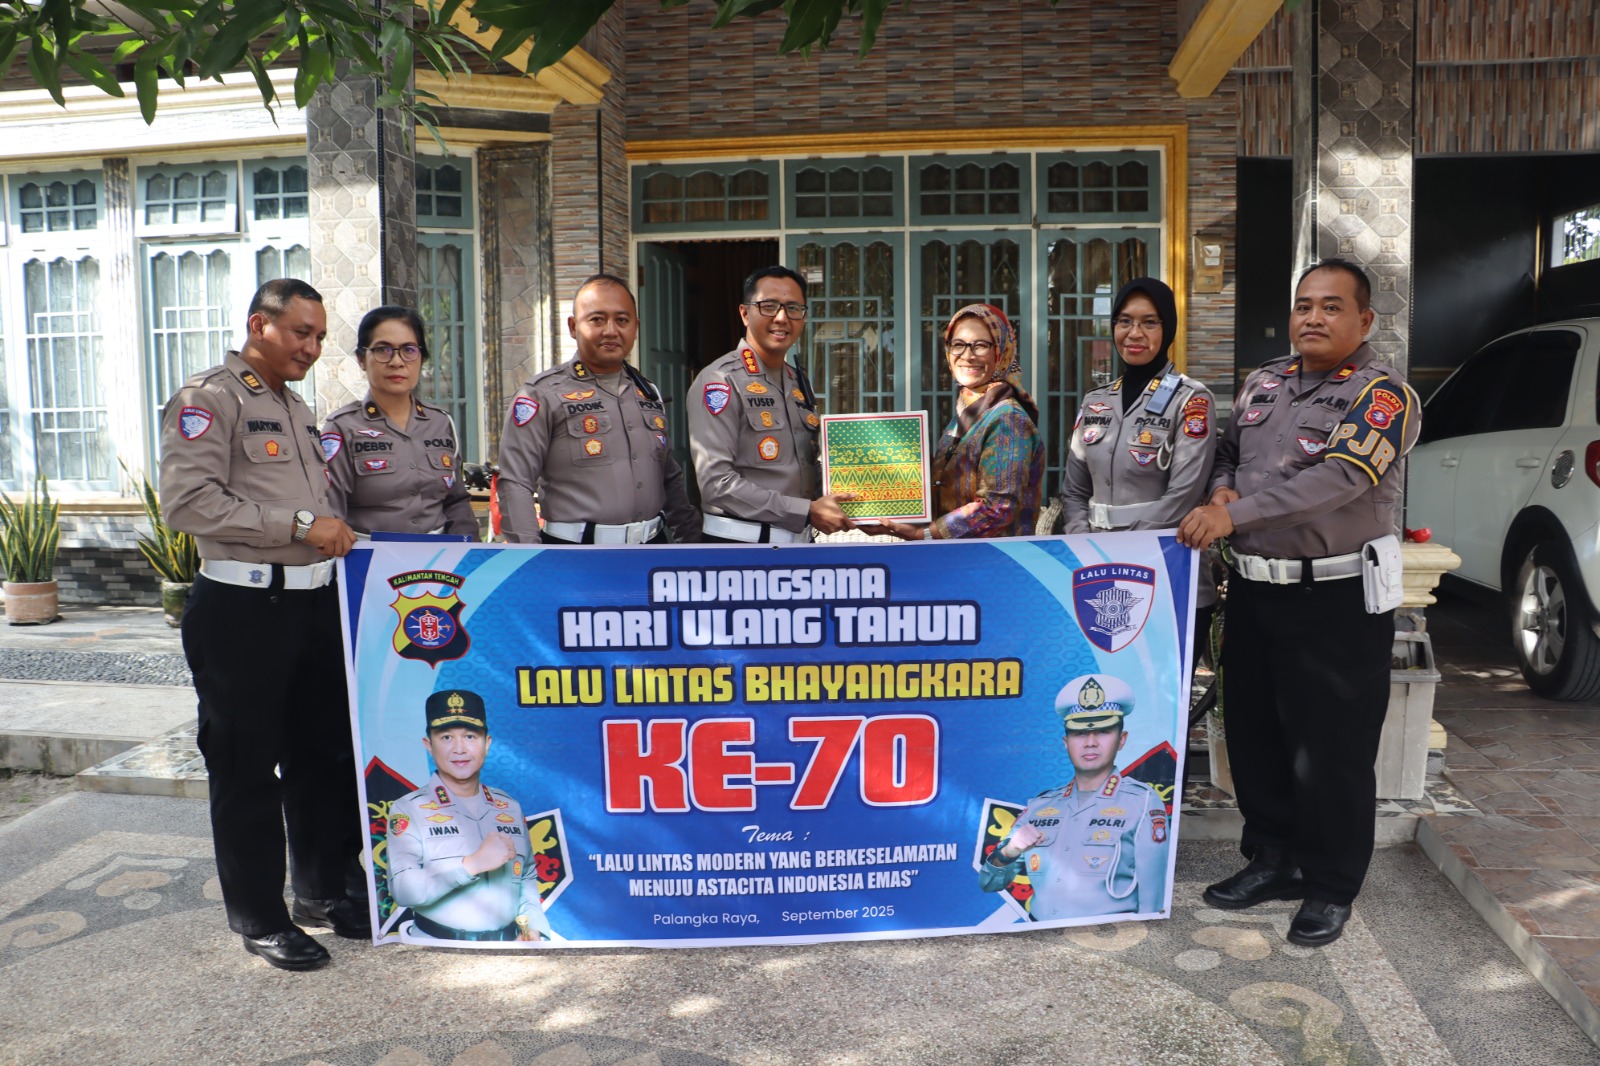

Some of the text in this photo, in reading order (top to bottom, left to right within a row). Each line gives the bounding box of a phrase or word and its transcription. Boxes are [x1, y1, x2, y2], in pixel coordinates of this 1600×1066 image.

[567, 401, 603, 414] DODIK
[747, 398, 775, 407] YUSEP
[355, 442, 393, 452] DEBBY
[1329, 423, 1396, 476] PJR
[393, 572, 460, 586] KALIMANTAN TENGAH
[1080, 568, 1149, 580] LALU LINTAS
[652, 567, 886, 603] ANJANGSANA
[562, 604, 977, 648] HARI ULANG TAHUN
[519, 661, 1021, 704] LALU LINTAS BHAYANGKARA
[602, 714, 940, 813] KE-70
[429, 825, 460, 836] IWAN
[497, 825, 522, 835] POLRI
[1088, 818, 1126, 828] POLRI
[741, 825, 794, 844] Tema
[637, 853, 693, 872] LINTAS
[697, 852, 766, 872] MODERN
[769, 850, 811, 870] YANG
[815, 843, 958, 868] BERKESELAMATAN
[629, 878, 693, 897] MENUJU
[696, 877, 774, 897] ASTACITA
[777, 872, 864, 894] INDONESIA
[653, 905, 895, 928] Palangka Raya, September 2025
